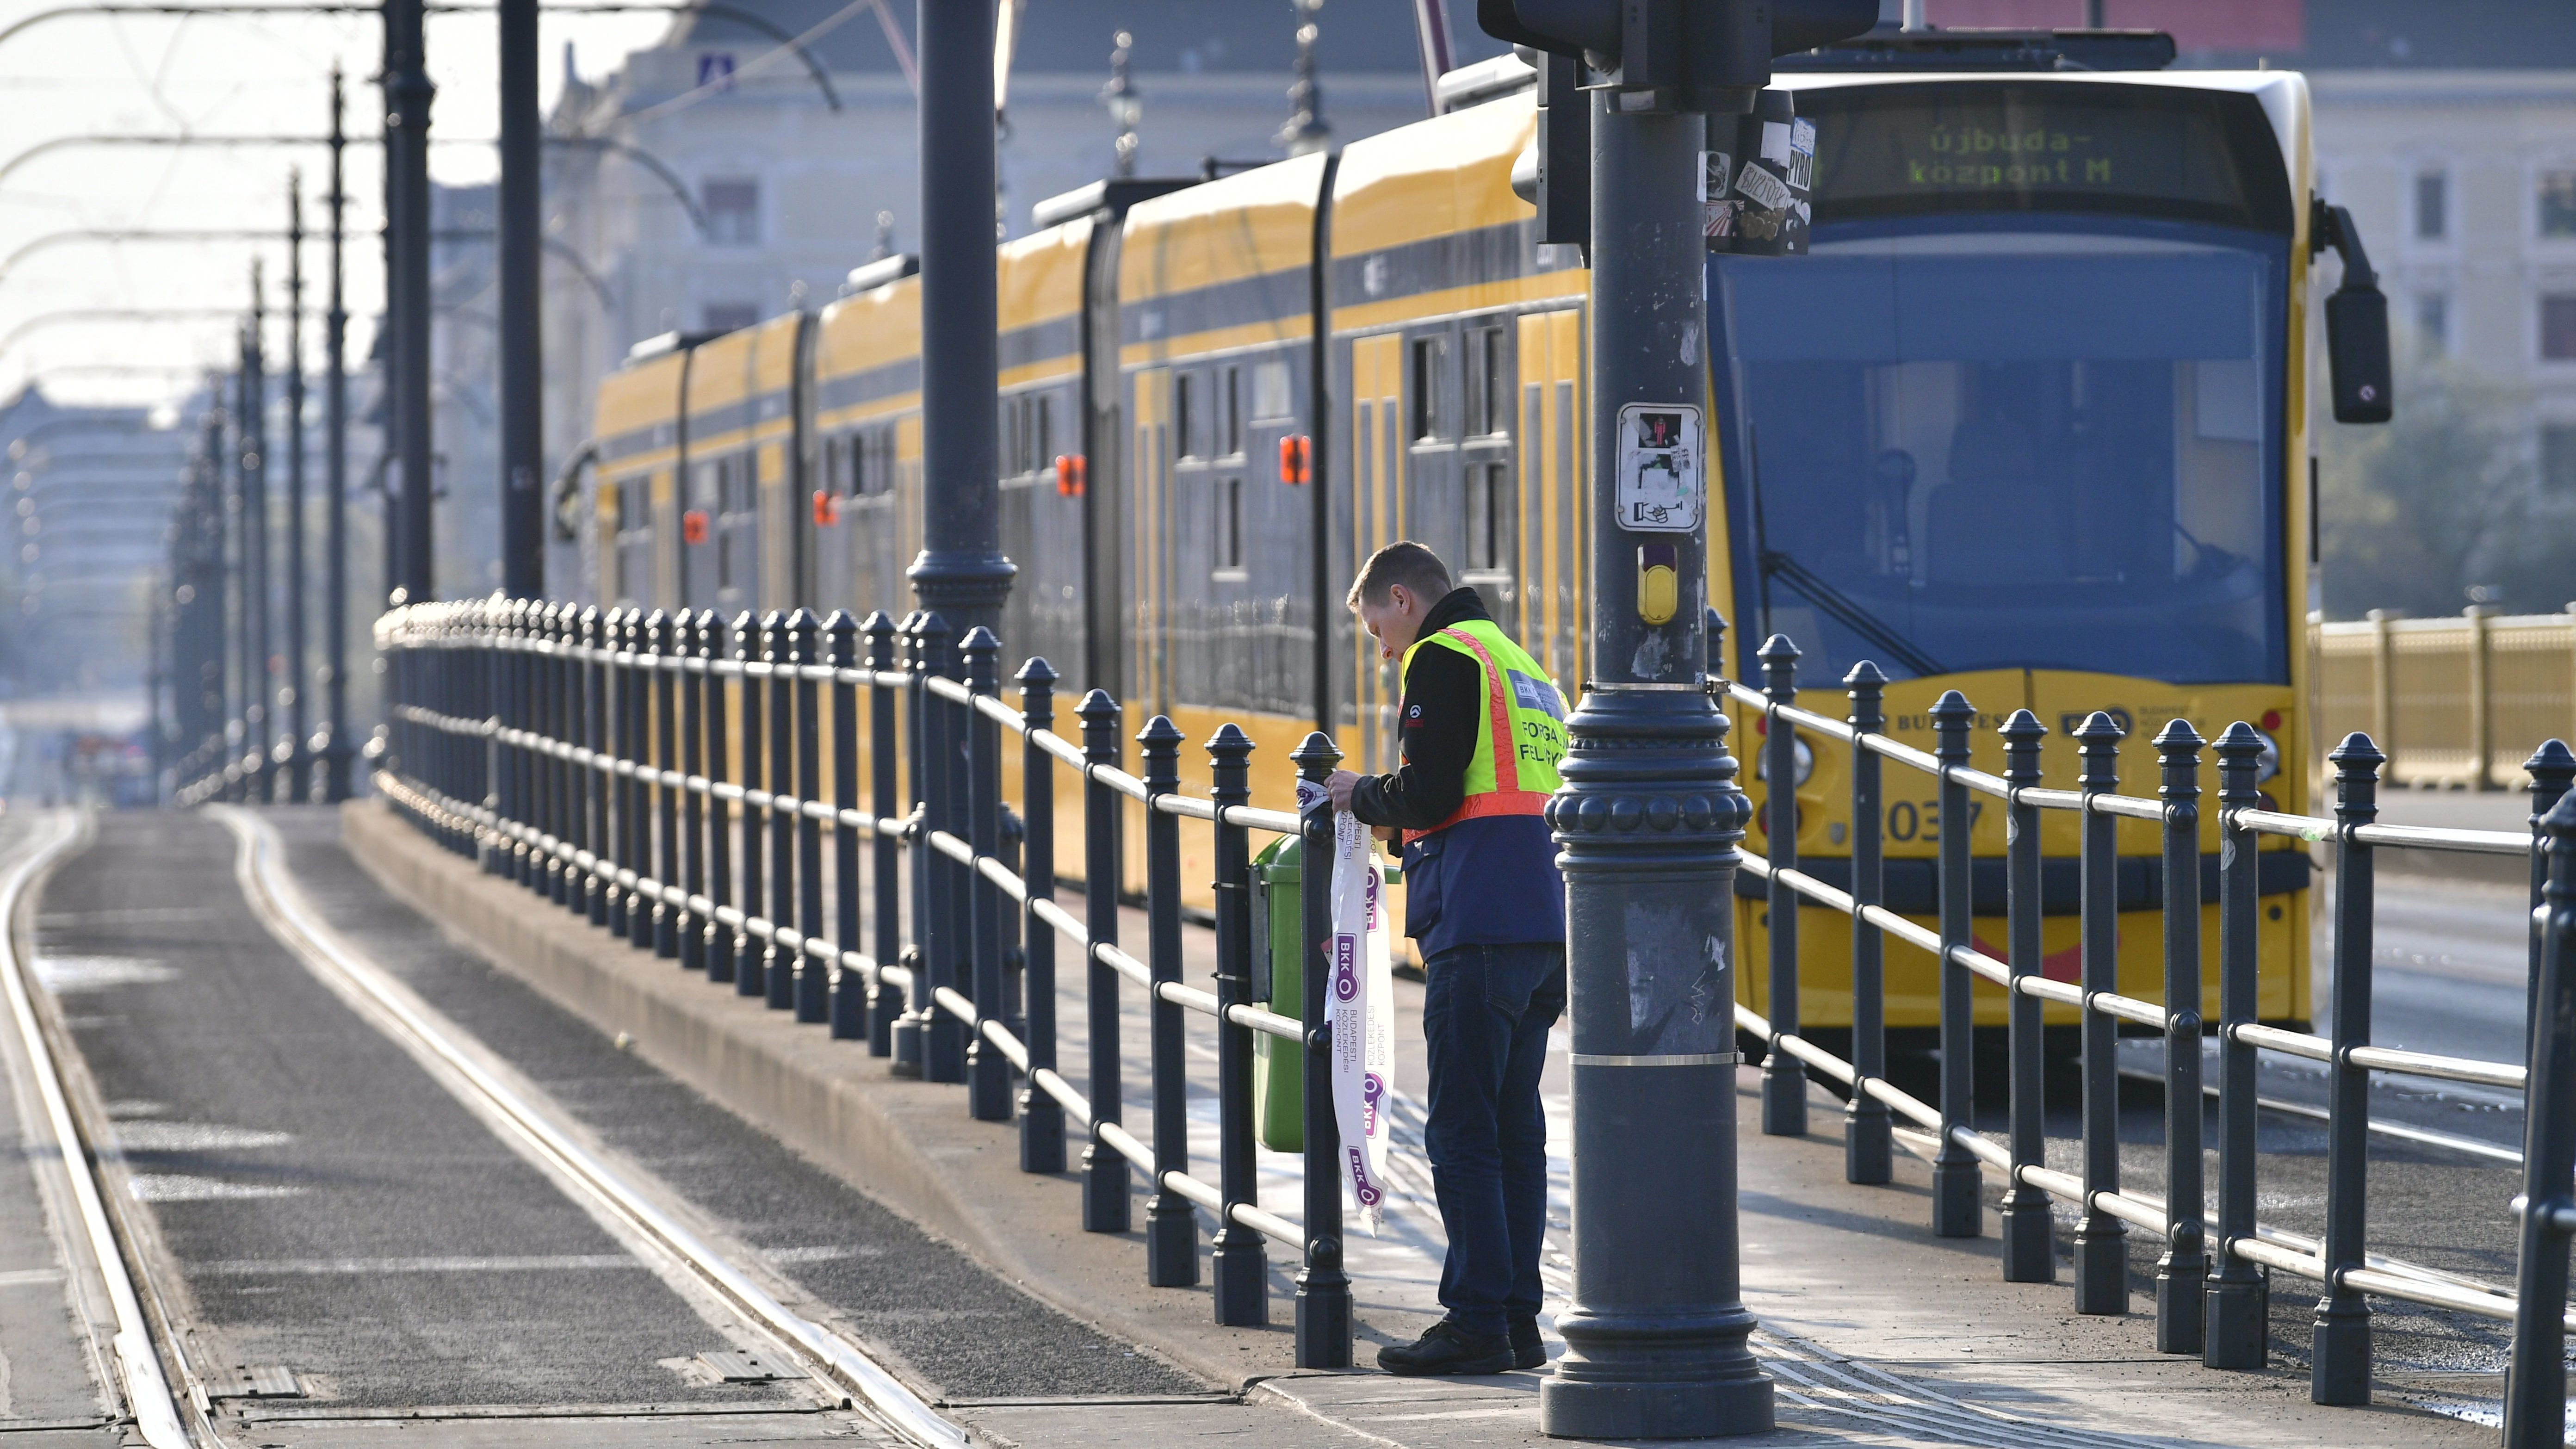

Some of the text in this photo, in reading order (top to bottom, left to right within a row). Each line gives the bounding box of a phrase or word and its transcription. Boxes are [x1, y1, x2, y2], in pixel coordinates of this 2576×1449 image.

[1787, 149, 1811, 187] PYRO
[2086, 159, 2111, 183] M
[1341, 943, 1350, 972] BKK
[1352, 1155, 1364, 1183] BKK
